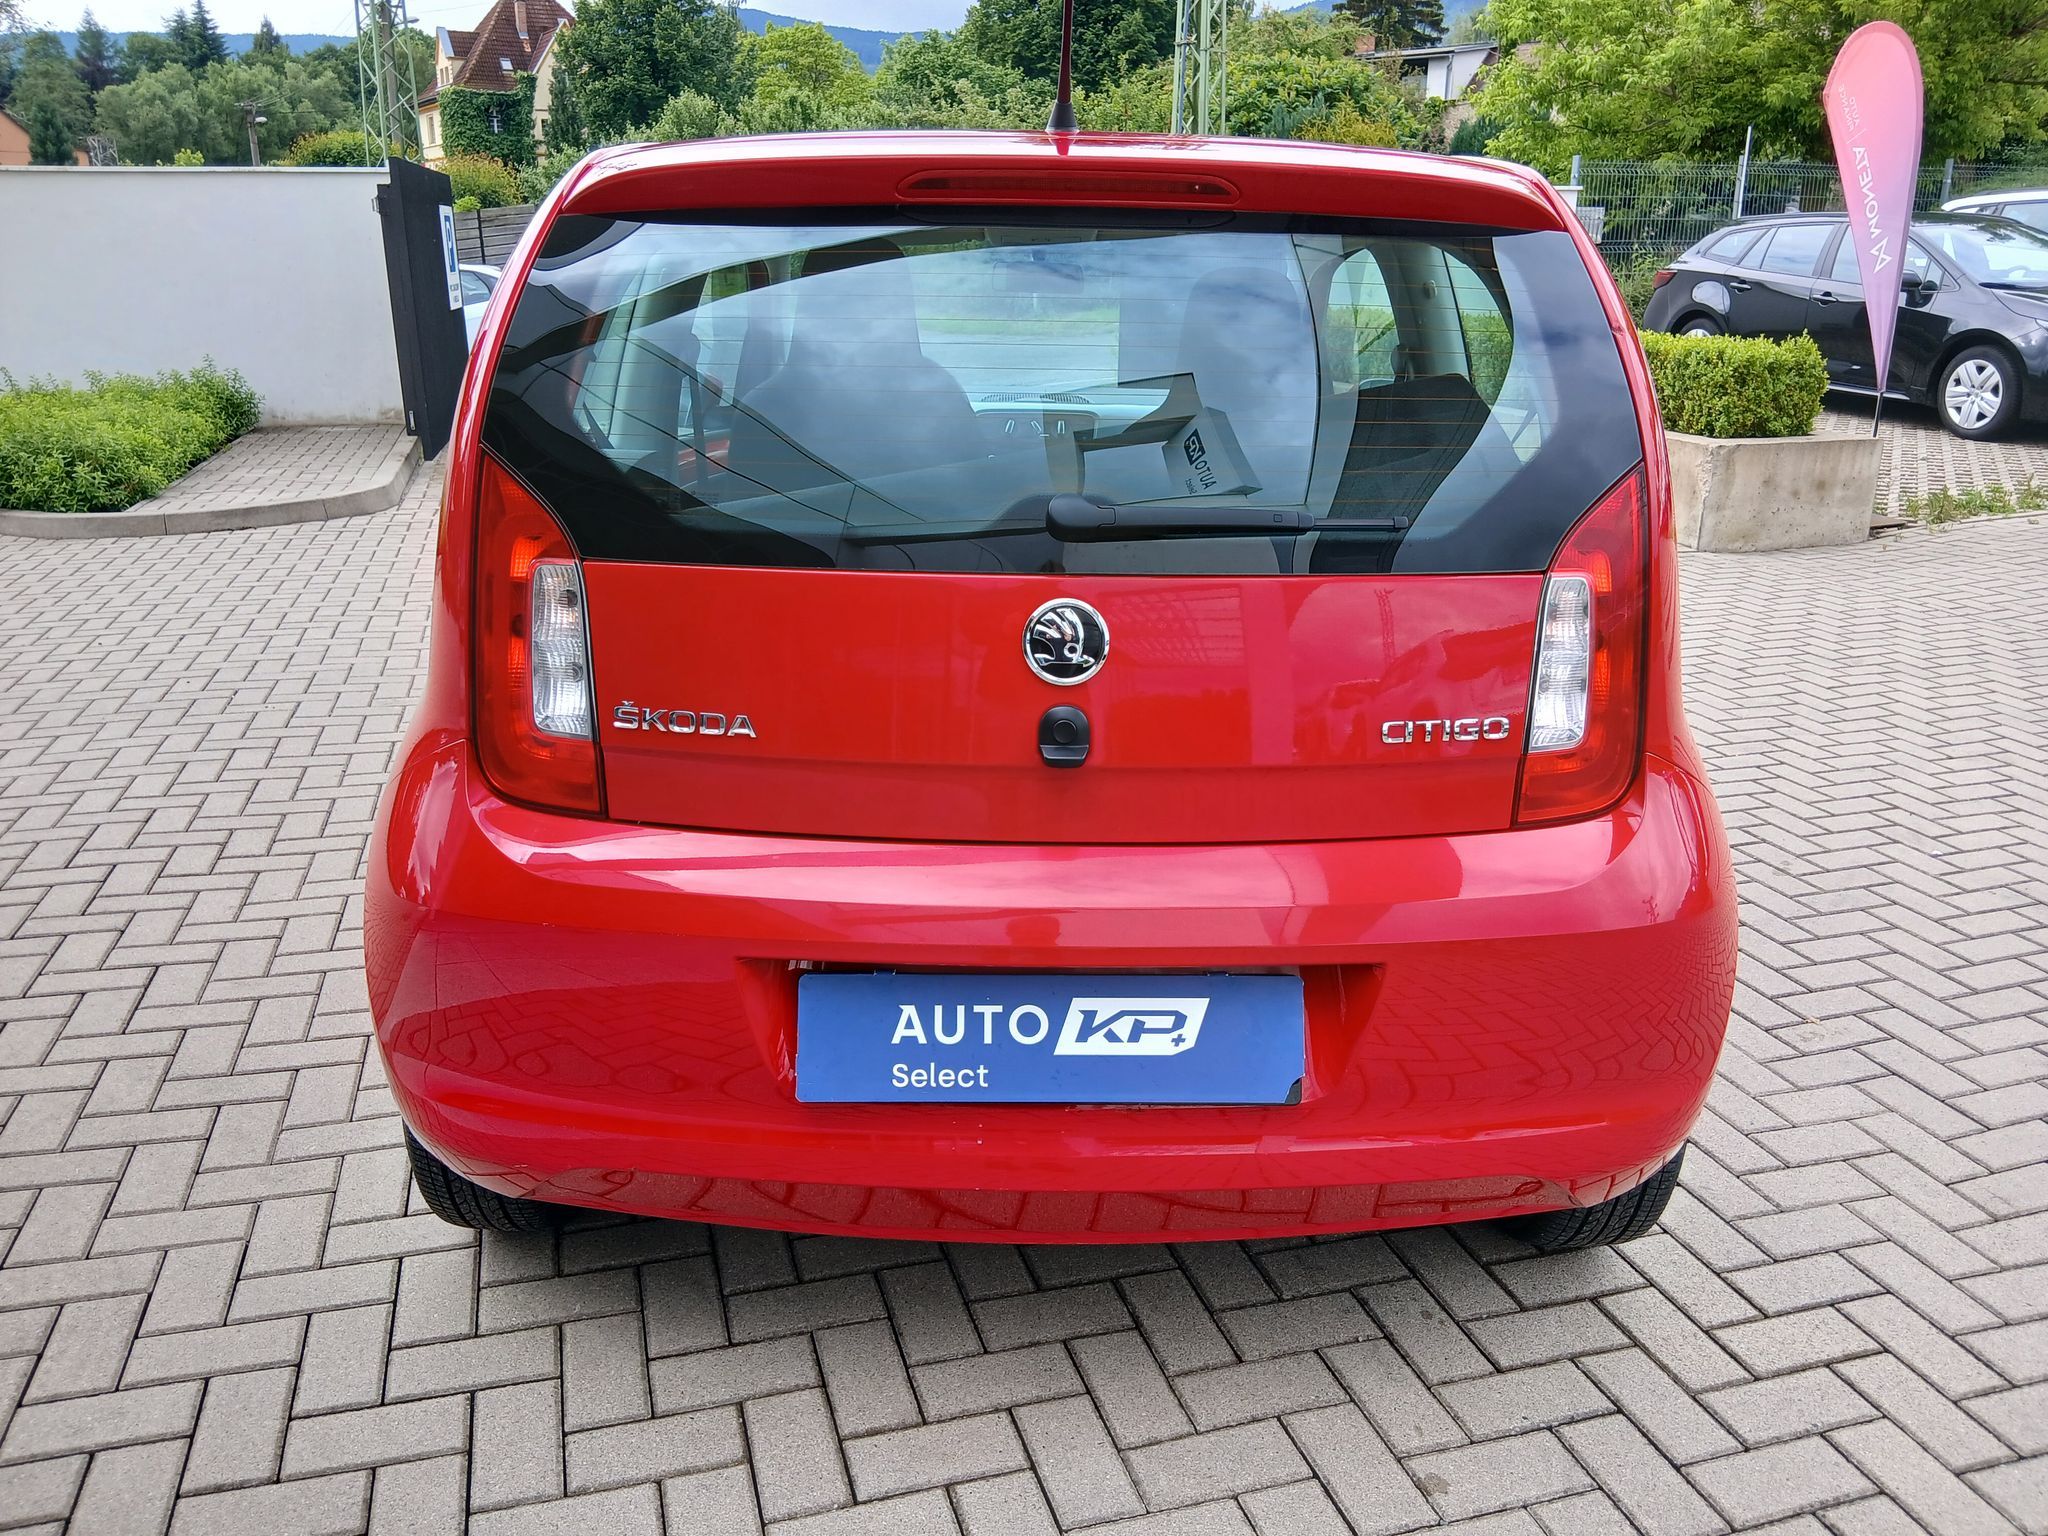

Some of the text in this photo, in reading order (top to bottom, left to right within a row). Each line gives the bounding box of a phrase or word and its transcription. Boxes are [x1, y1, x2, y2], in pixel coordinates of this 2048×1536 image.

[613, 701, 757, 738] ŠKODA
[1382, 717, 1510, 744] CITIGO
[891, 1004, 1049, 1045] AUTO
[891, 1063, 989, 1089] Select
